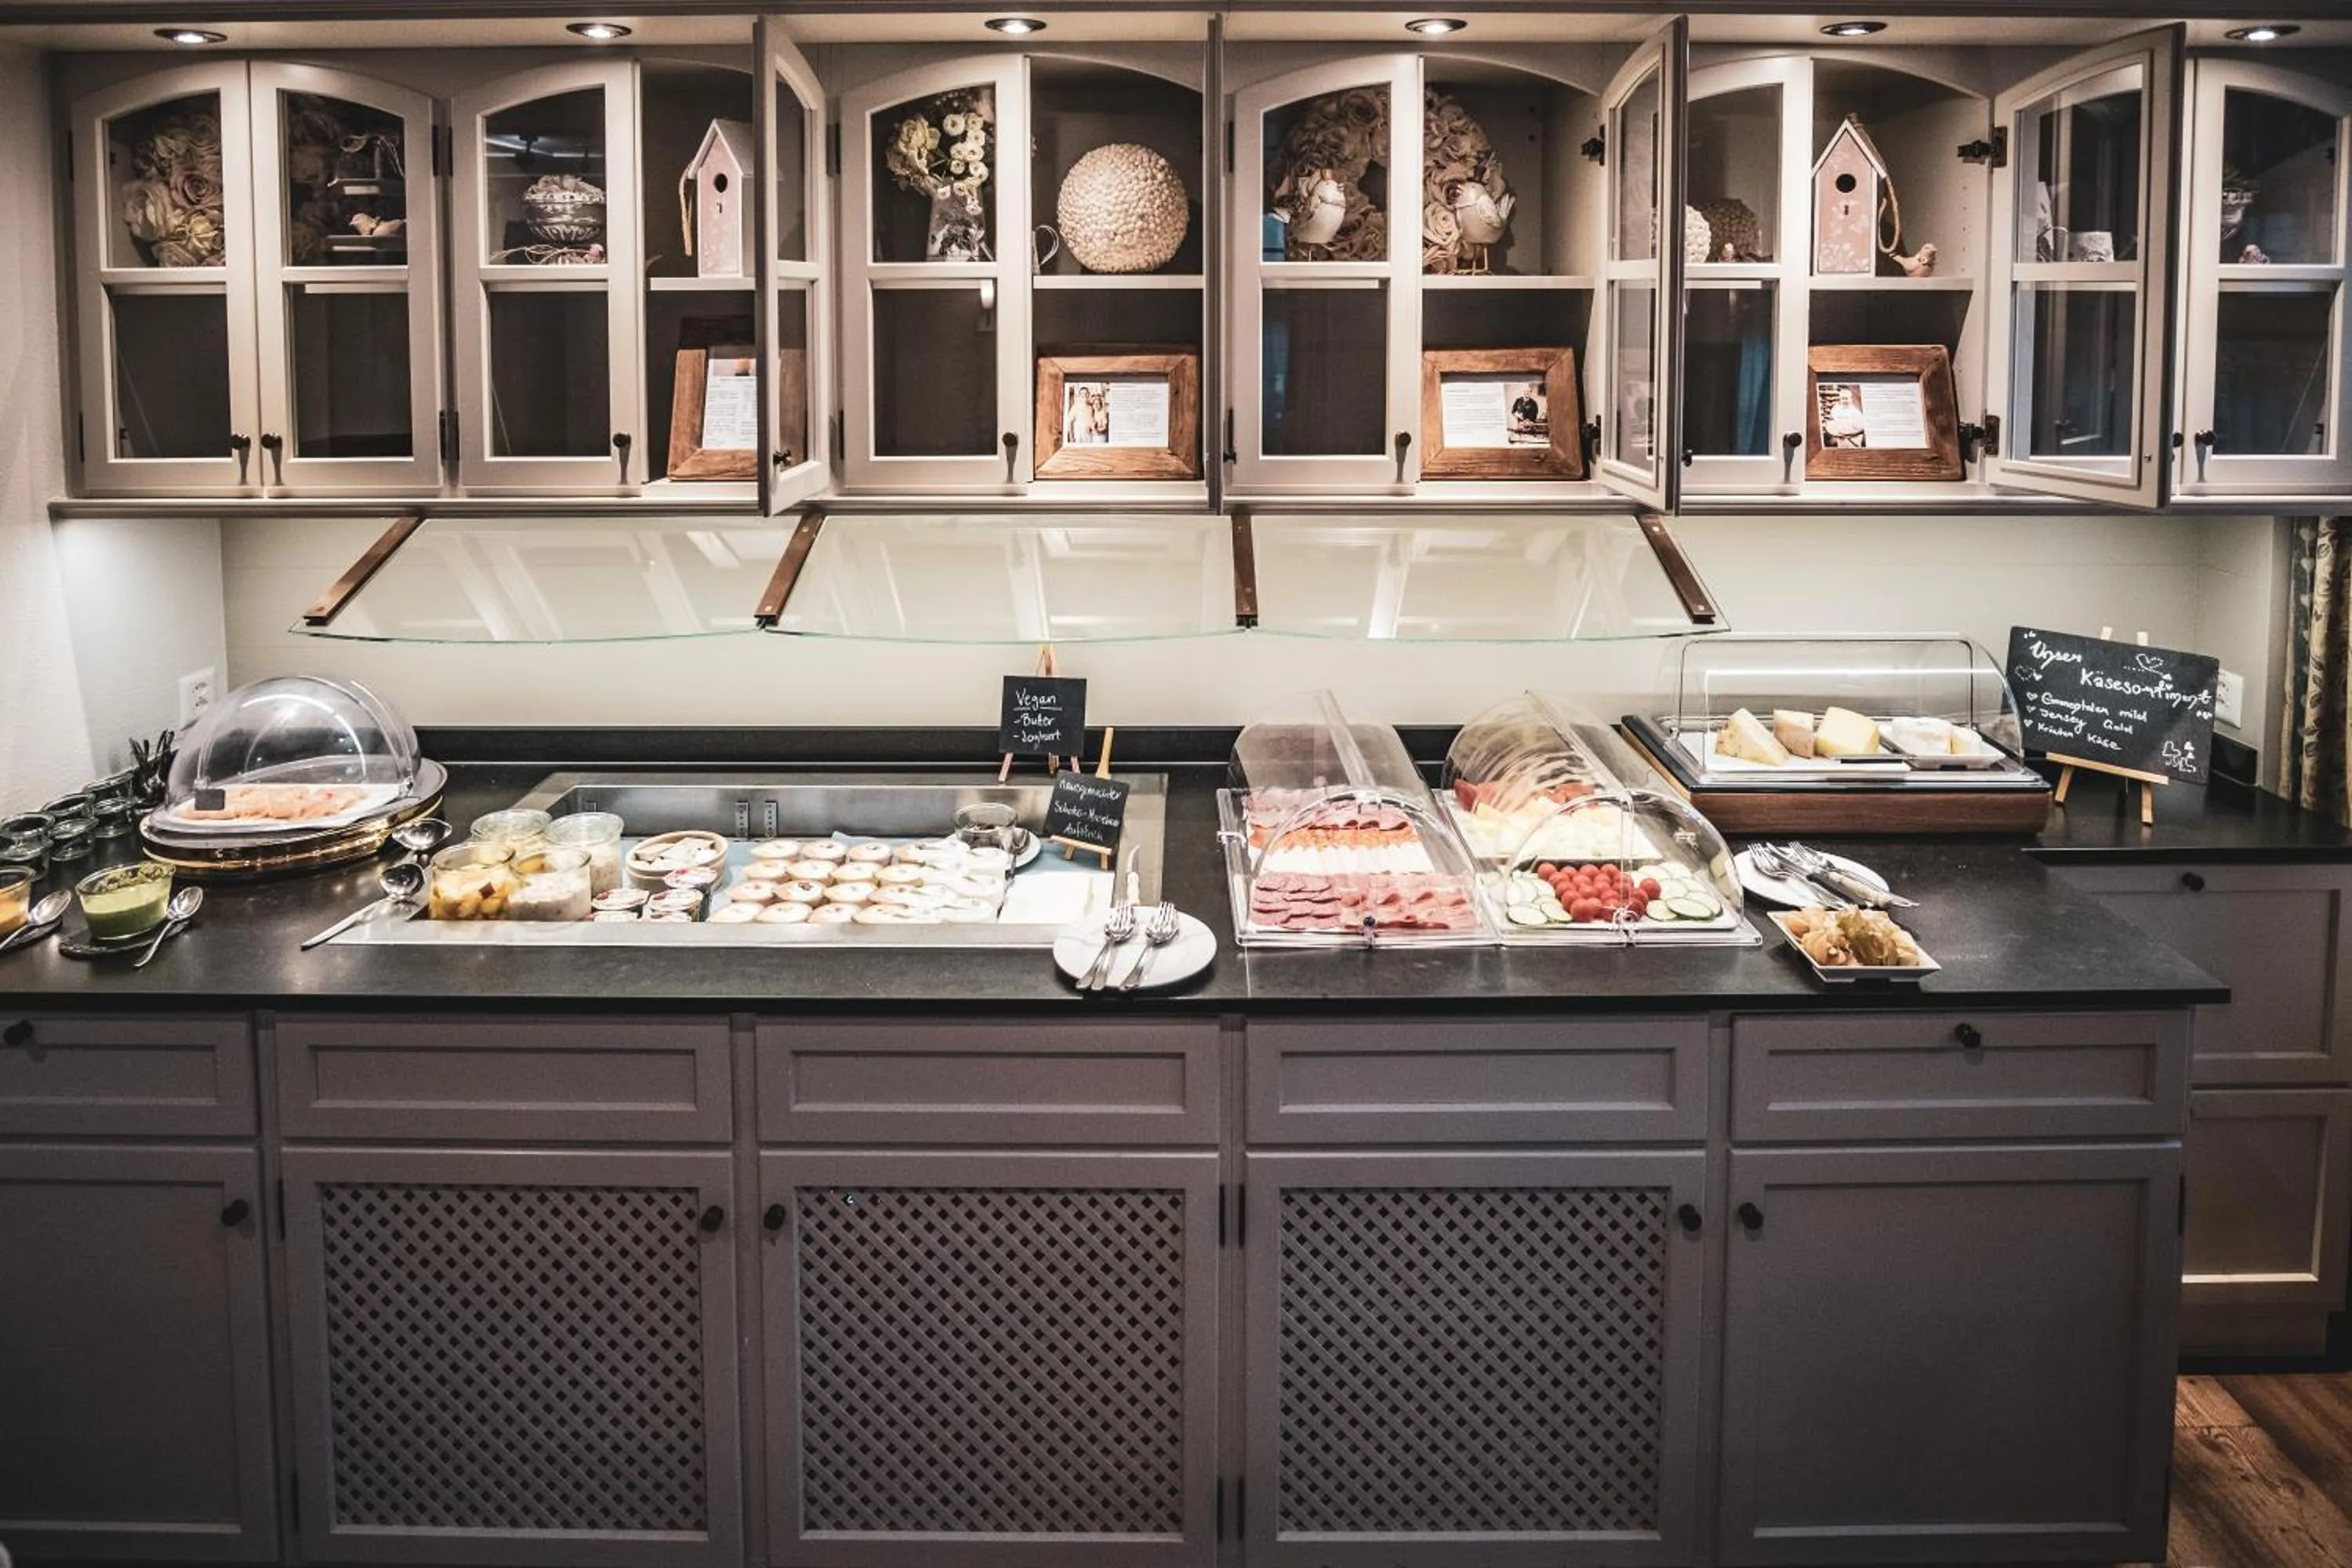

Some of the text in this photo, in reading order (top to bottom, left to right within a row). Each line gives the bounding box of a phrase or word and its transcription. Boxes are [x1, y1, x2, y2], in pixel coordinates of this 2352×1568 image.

[1015, 687, 1056, 711] Vegan
[2039, 708, 2133, 735] Jersey Gold
[2119, 709, 2147, 722] mild
